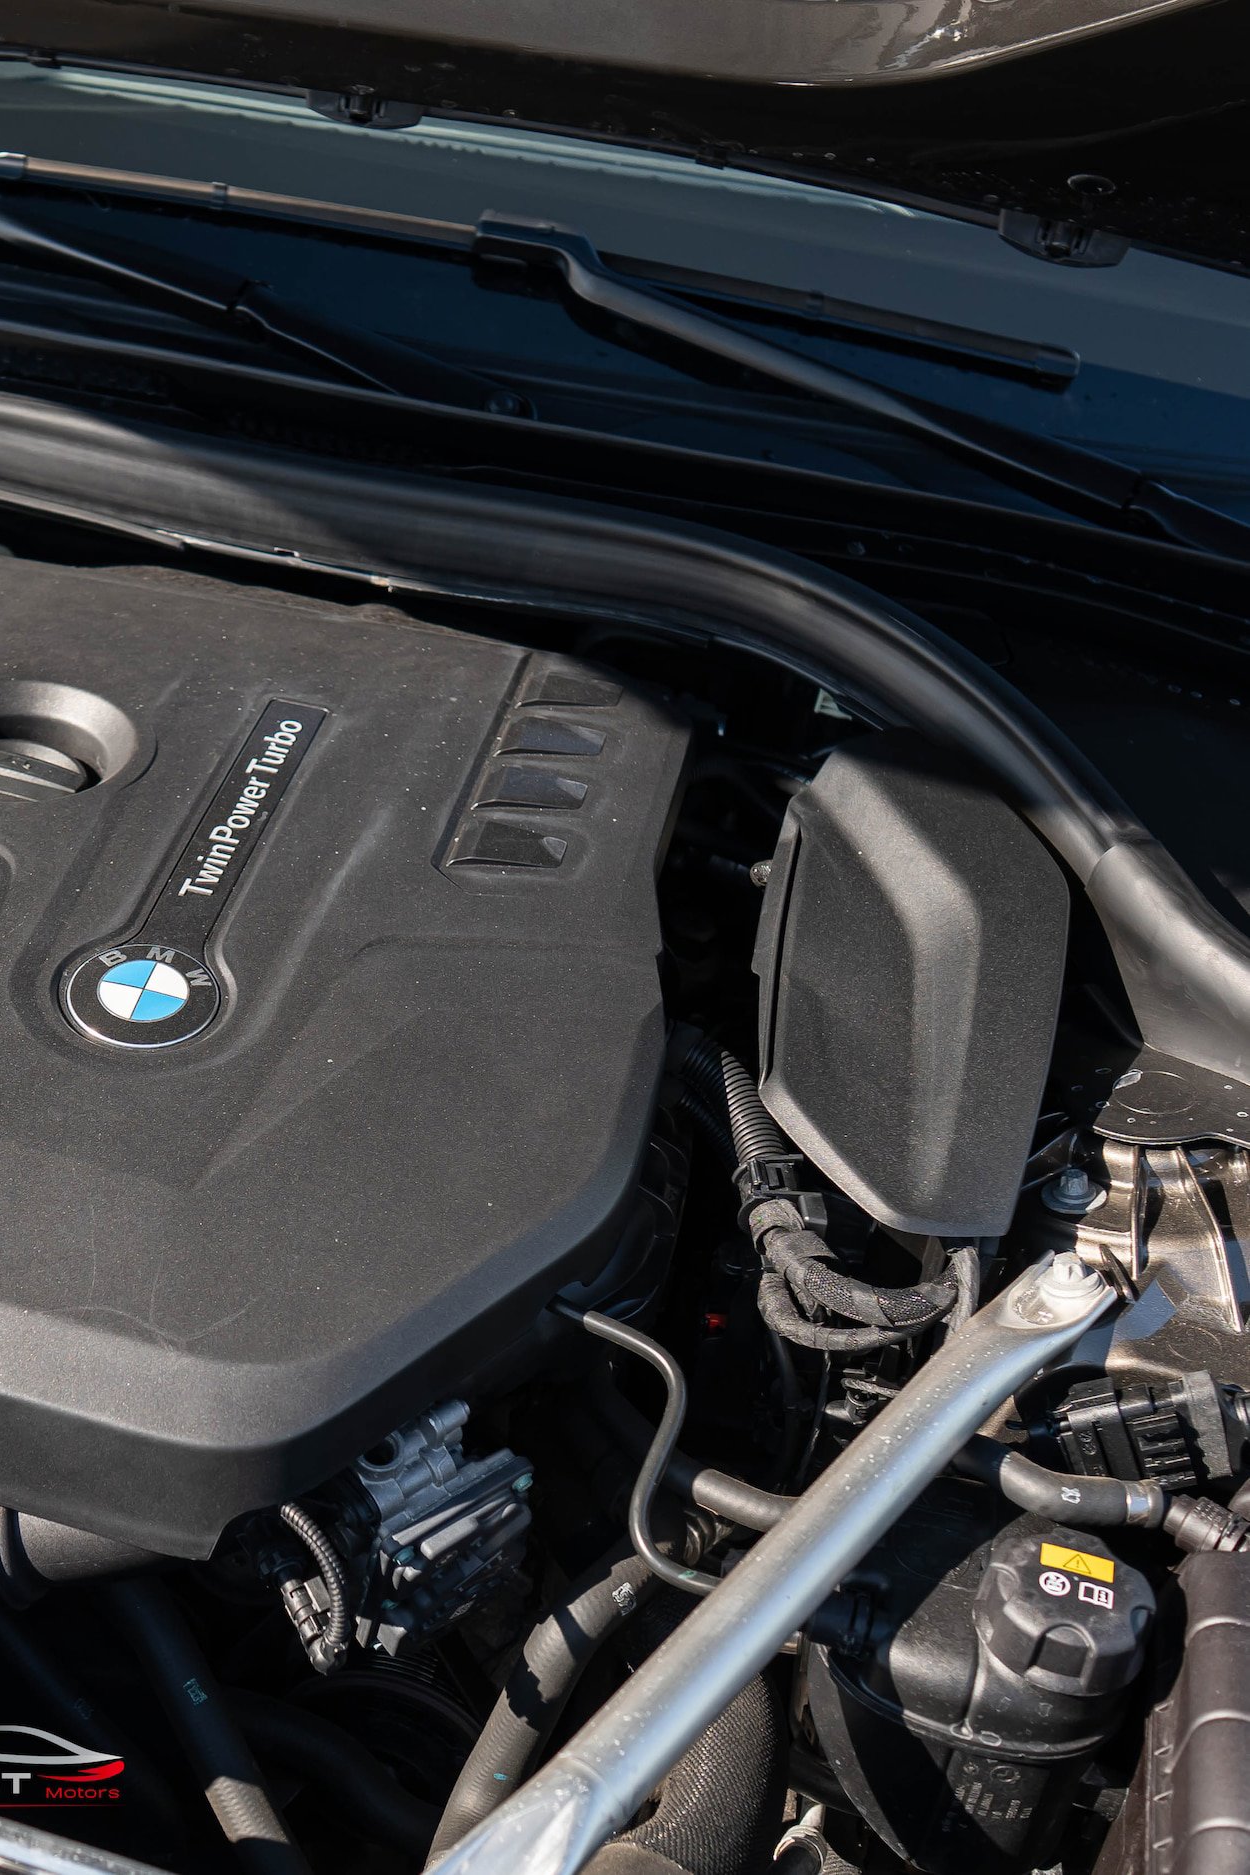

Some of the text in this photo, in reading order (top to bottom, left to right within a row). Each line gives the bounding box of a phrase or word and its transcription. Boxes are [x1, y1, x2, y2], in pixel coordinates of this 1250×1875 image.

[178, 719, 302, 896] TwinPower Turbo
[99, 946, 212, 988] BMW
